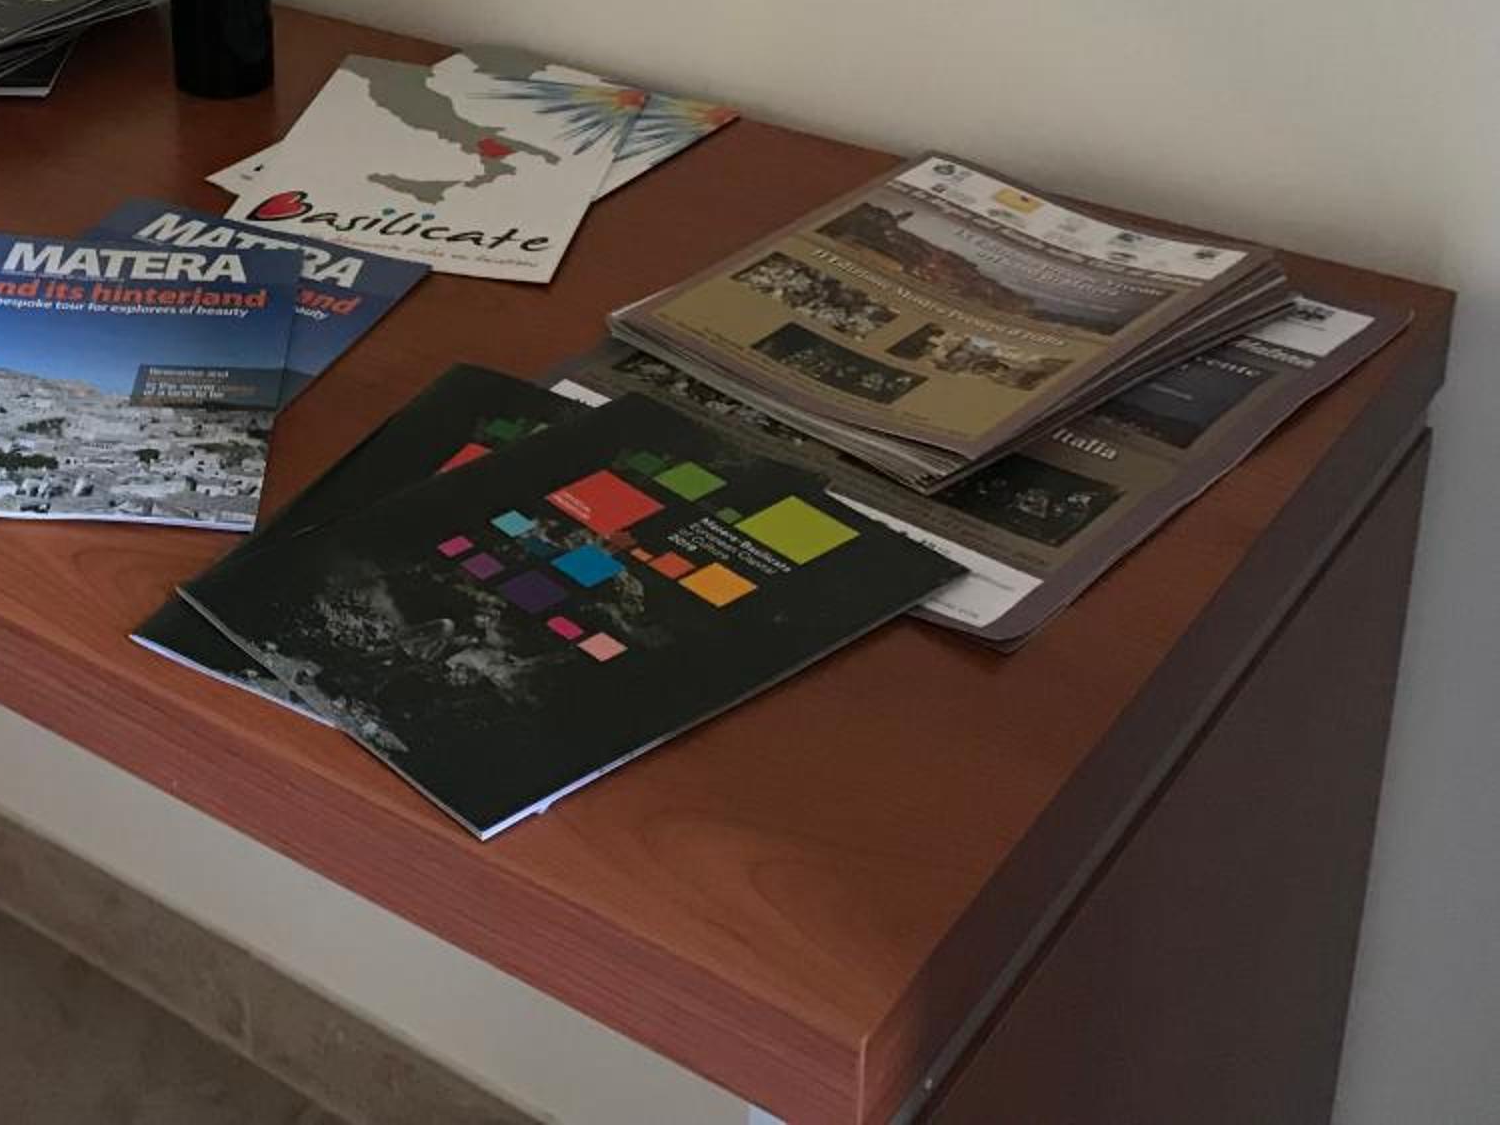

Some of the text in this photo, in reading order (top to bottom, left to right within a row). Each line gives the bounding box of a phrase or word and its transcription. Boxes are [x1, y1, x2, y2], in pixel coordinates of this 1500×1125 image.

[1, 241, 248, 284] MATERA
[132, 213, 365, 288] MATRA
[45, 281, 85, 301] its
[92, 283, 268, 309] hinterland
[55, 299, 84, 311] tour
[88, 302, 109, 313] for
[110, 303, 177, 317] explorers
[179, 305, 196, 316] of
[196, 306, 249, 321] beauty
